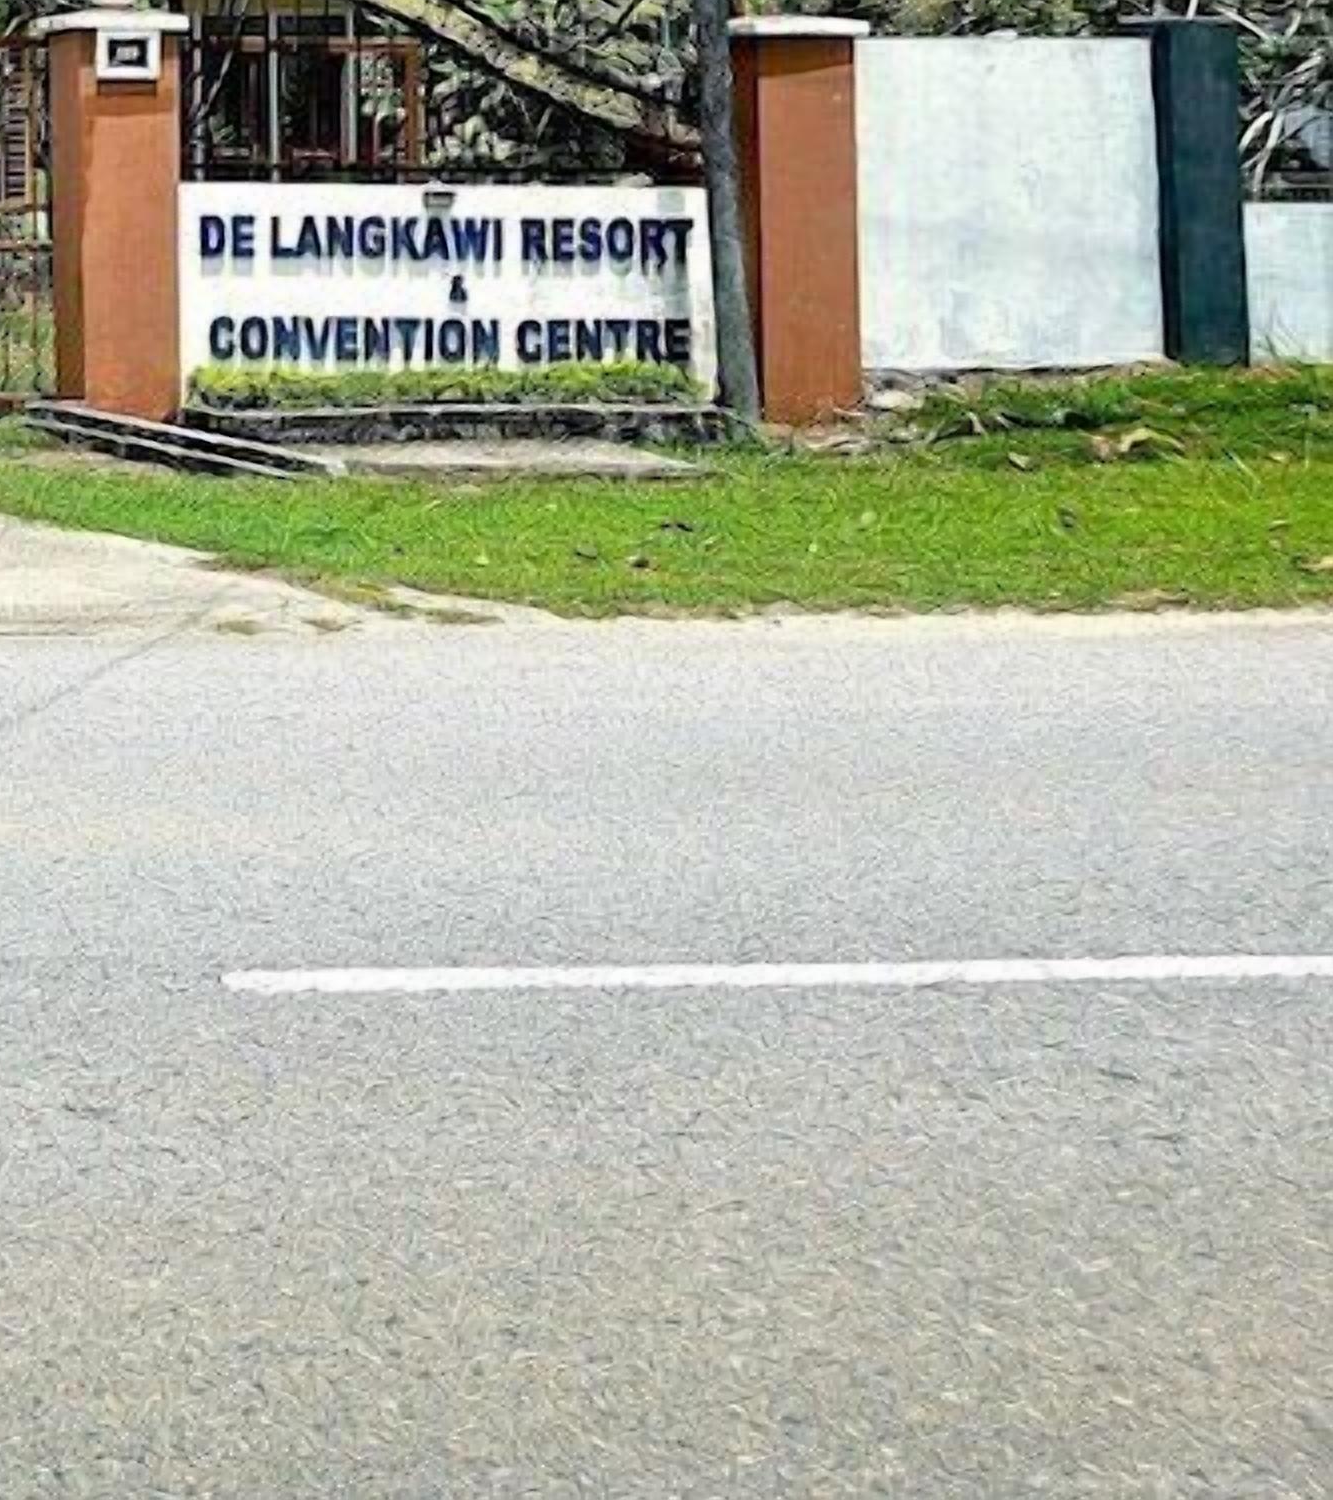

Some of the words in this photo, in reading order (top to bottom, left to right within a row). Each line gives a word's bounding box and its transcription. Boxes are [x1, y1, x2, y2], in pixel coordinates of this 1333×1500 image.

[199, 214, 255, 259] DE
[269, 215, 504, 262] LANGKAWI
[520, 217, 694, 265] RESORT
[207, 316, 501, 363] CONVENTION
[516, 318, 691, 363] CENTRE
